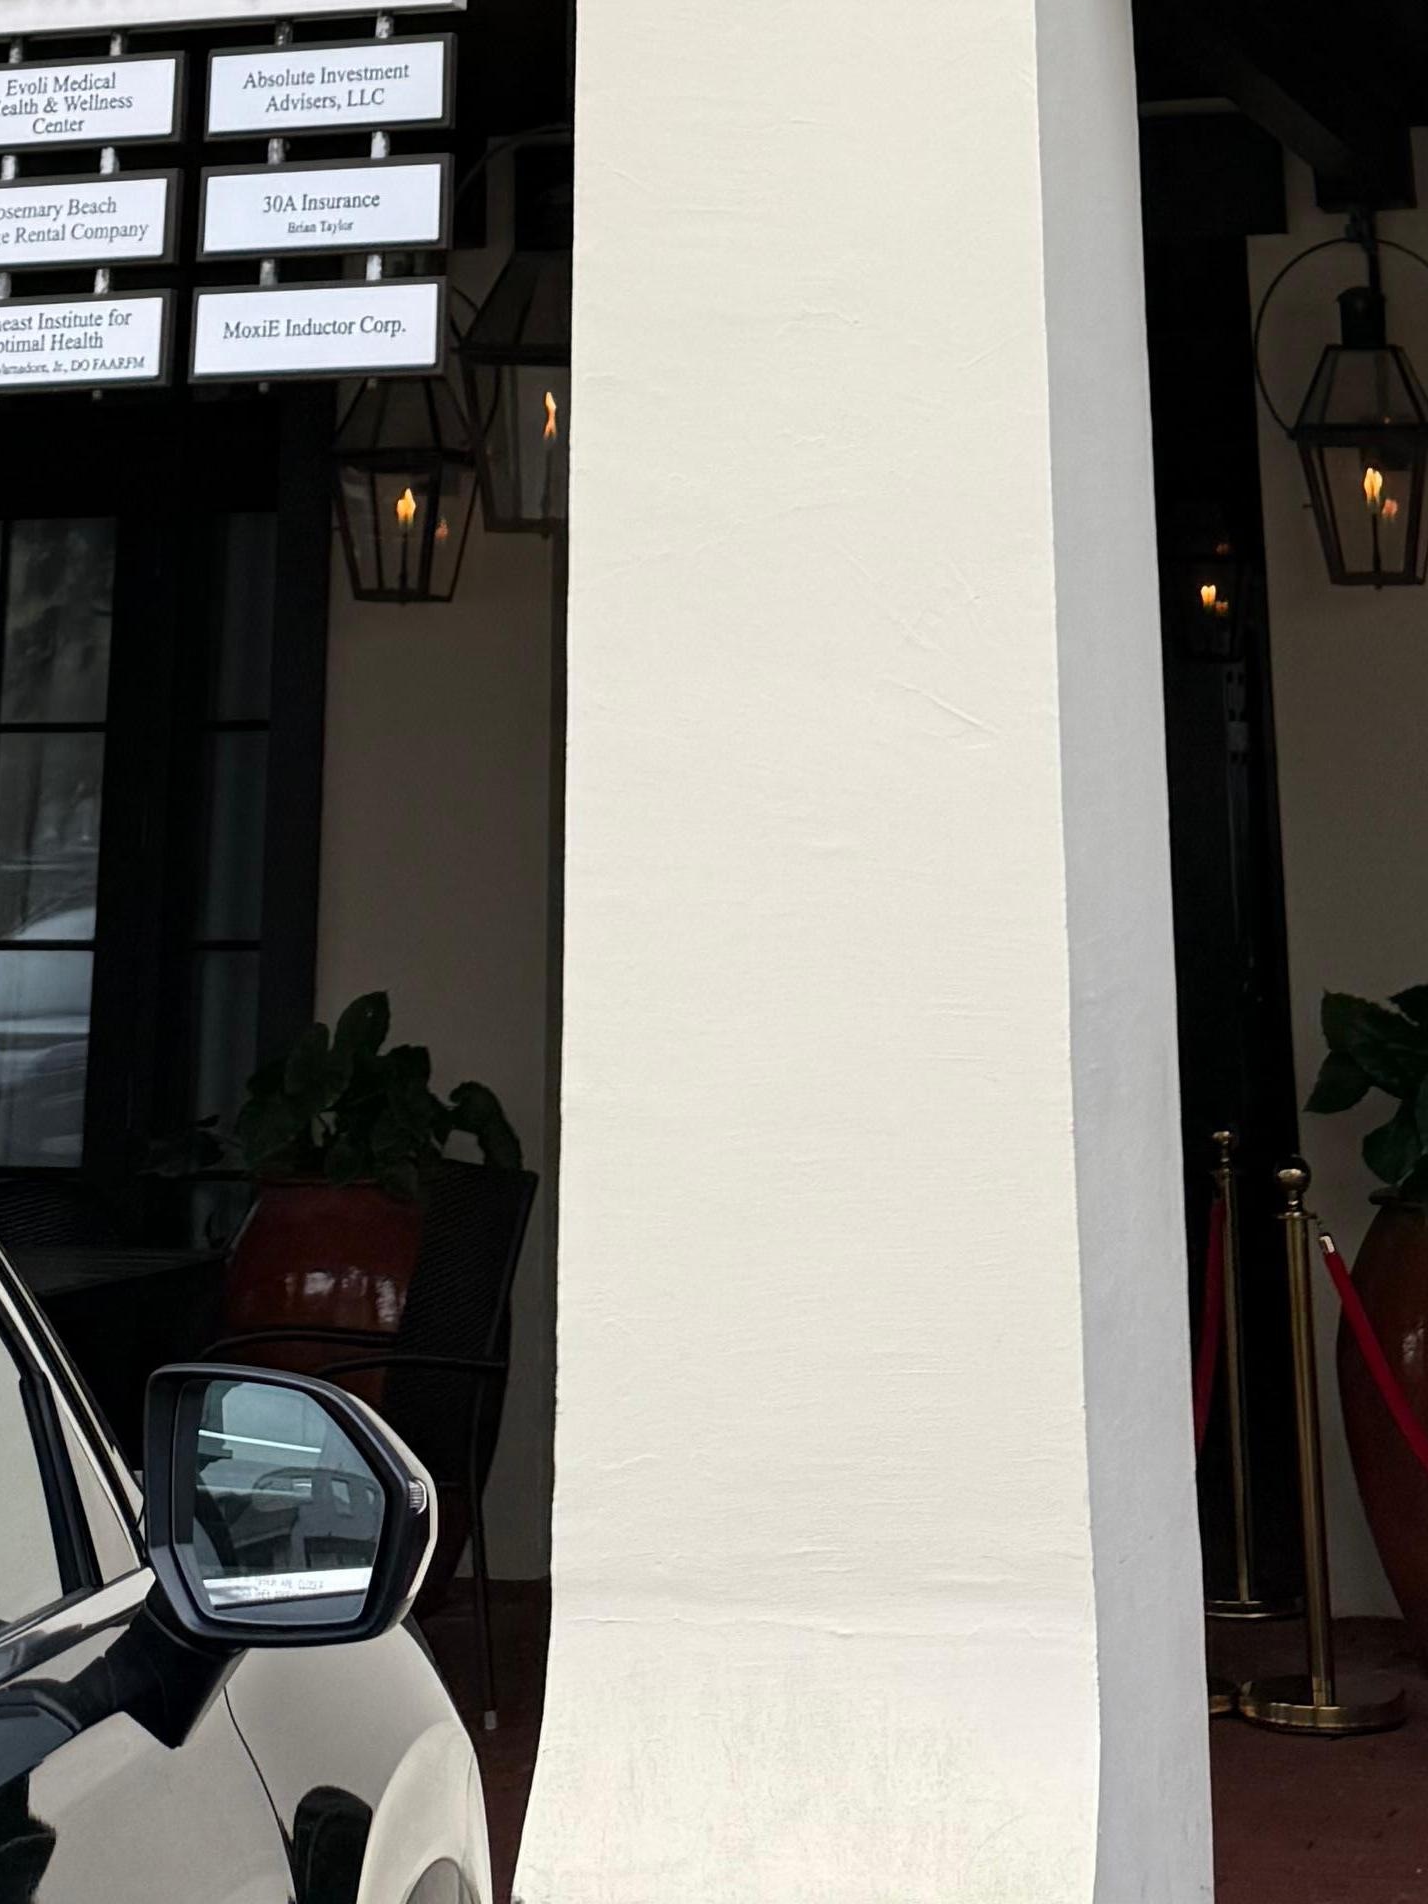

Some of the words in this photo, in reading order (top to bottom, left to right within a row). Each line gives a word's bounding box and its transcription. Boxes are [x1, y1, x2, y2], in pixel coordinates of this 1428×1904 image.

[5, 77, 48, 96] Evoli
[53, 71, 116, 93] Medical
[242, 69, 315, 89] Absolute
[321, 63, 409, 84] Investment
[43, 97, 58, 114] &
[64, 93, 133, 111] Wellness
[265, 92, 341, 113] Advisers,
[347, 88, 385, 107] LLC
[32, 116, 85, 134] Center
[68, 196, 117, 216] Beach
[263, 195, 297, 213] 30A
[302, 193, 381, 211] Insurance
[15, 224, 66, 243] Rental
[71, 222, 150, 242] Company
[37, 311, 105, 330] Institute
[109, 308, 132, 326] for
[223, 319, 280, 339] MoxiE
[285, 318, 356, 337] Inductor
[360, 315, 407, 337] Corp.
[50, 331, 104, 350] Health
